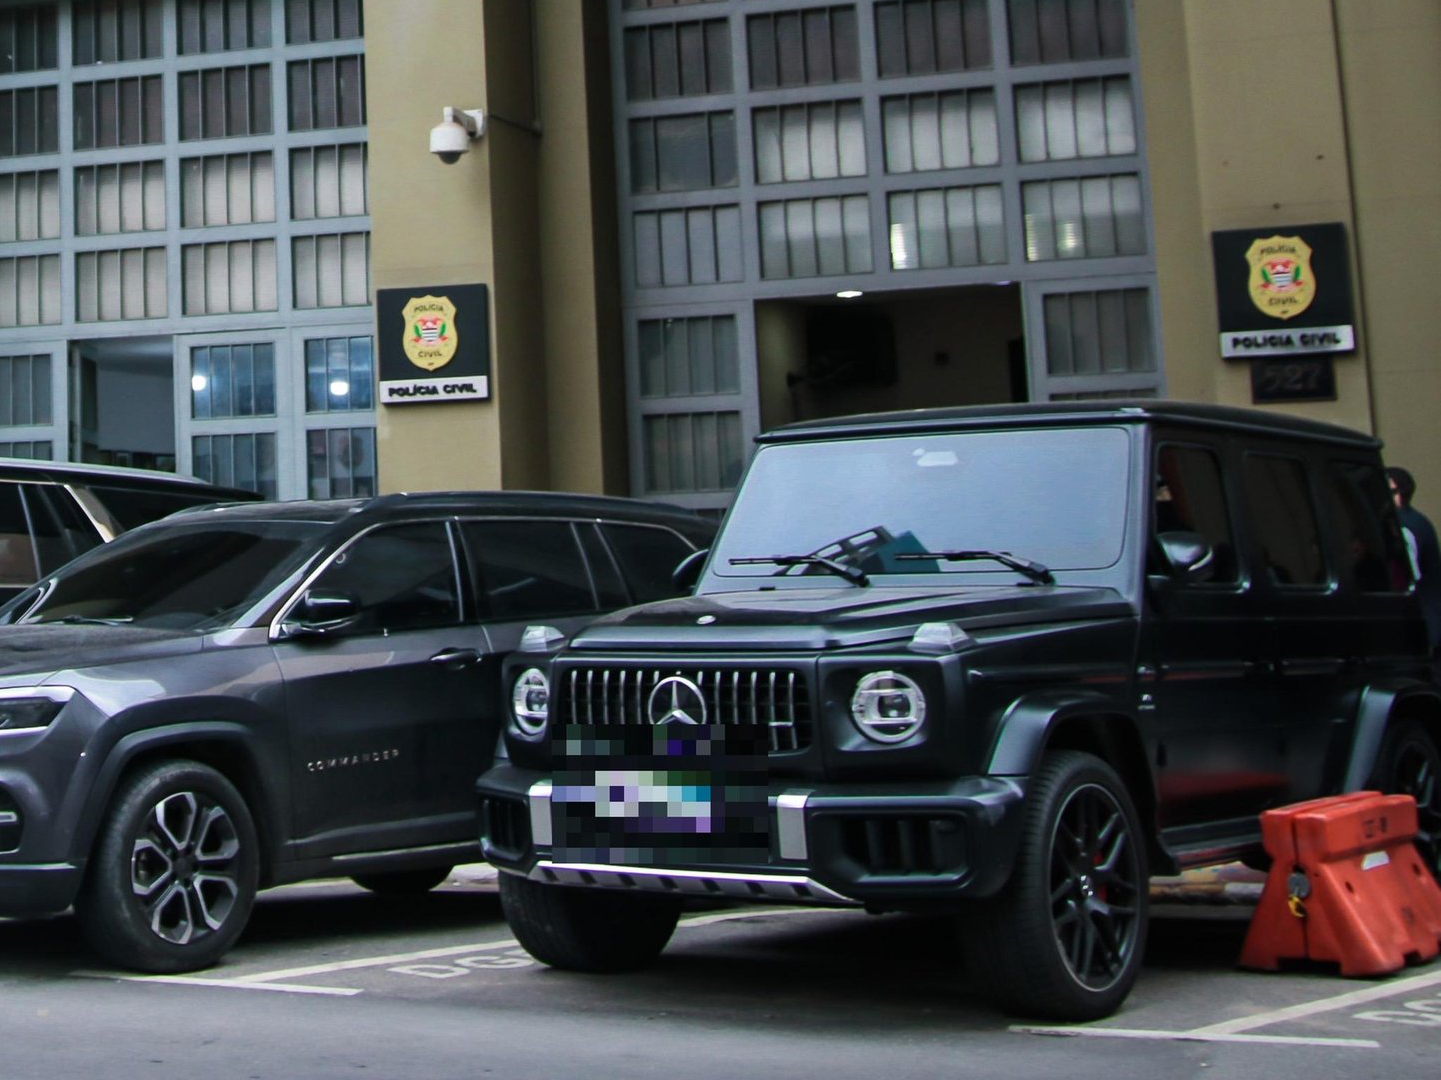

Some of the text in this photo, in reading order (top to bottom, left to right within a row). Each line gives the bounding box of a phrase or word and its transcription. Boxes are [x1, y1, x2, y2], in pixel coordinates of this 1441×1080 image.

[1300, 332, 1341, 347] CIVIL
[388, 383, 477, 397] POLÍCIA CIVIL
[307, 749, 400, 772] COMMANDER
